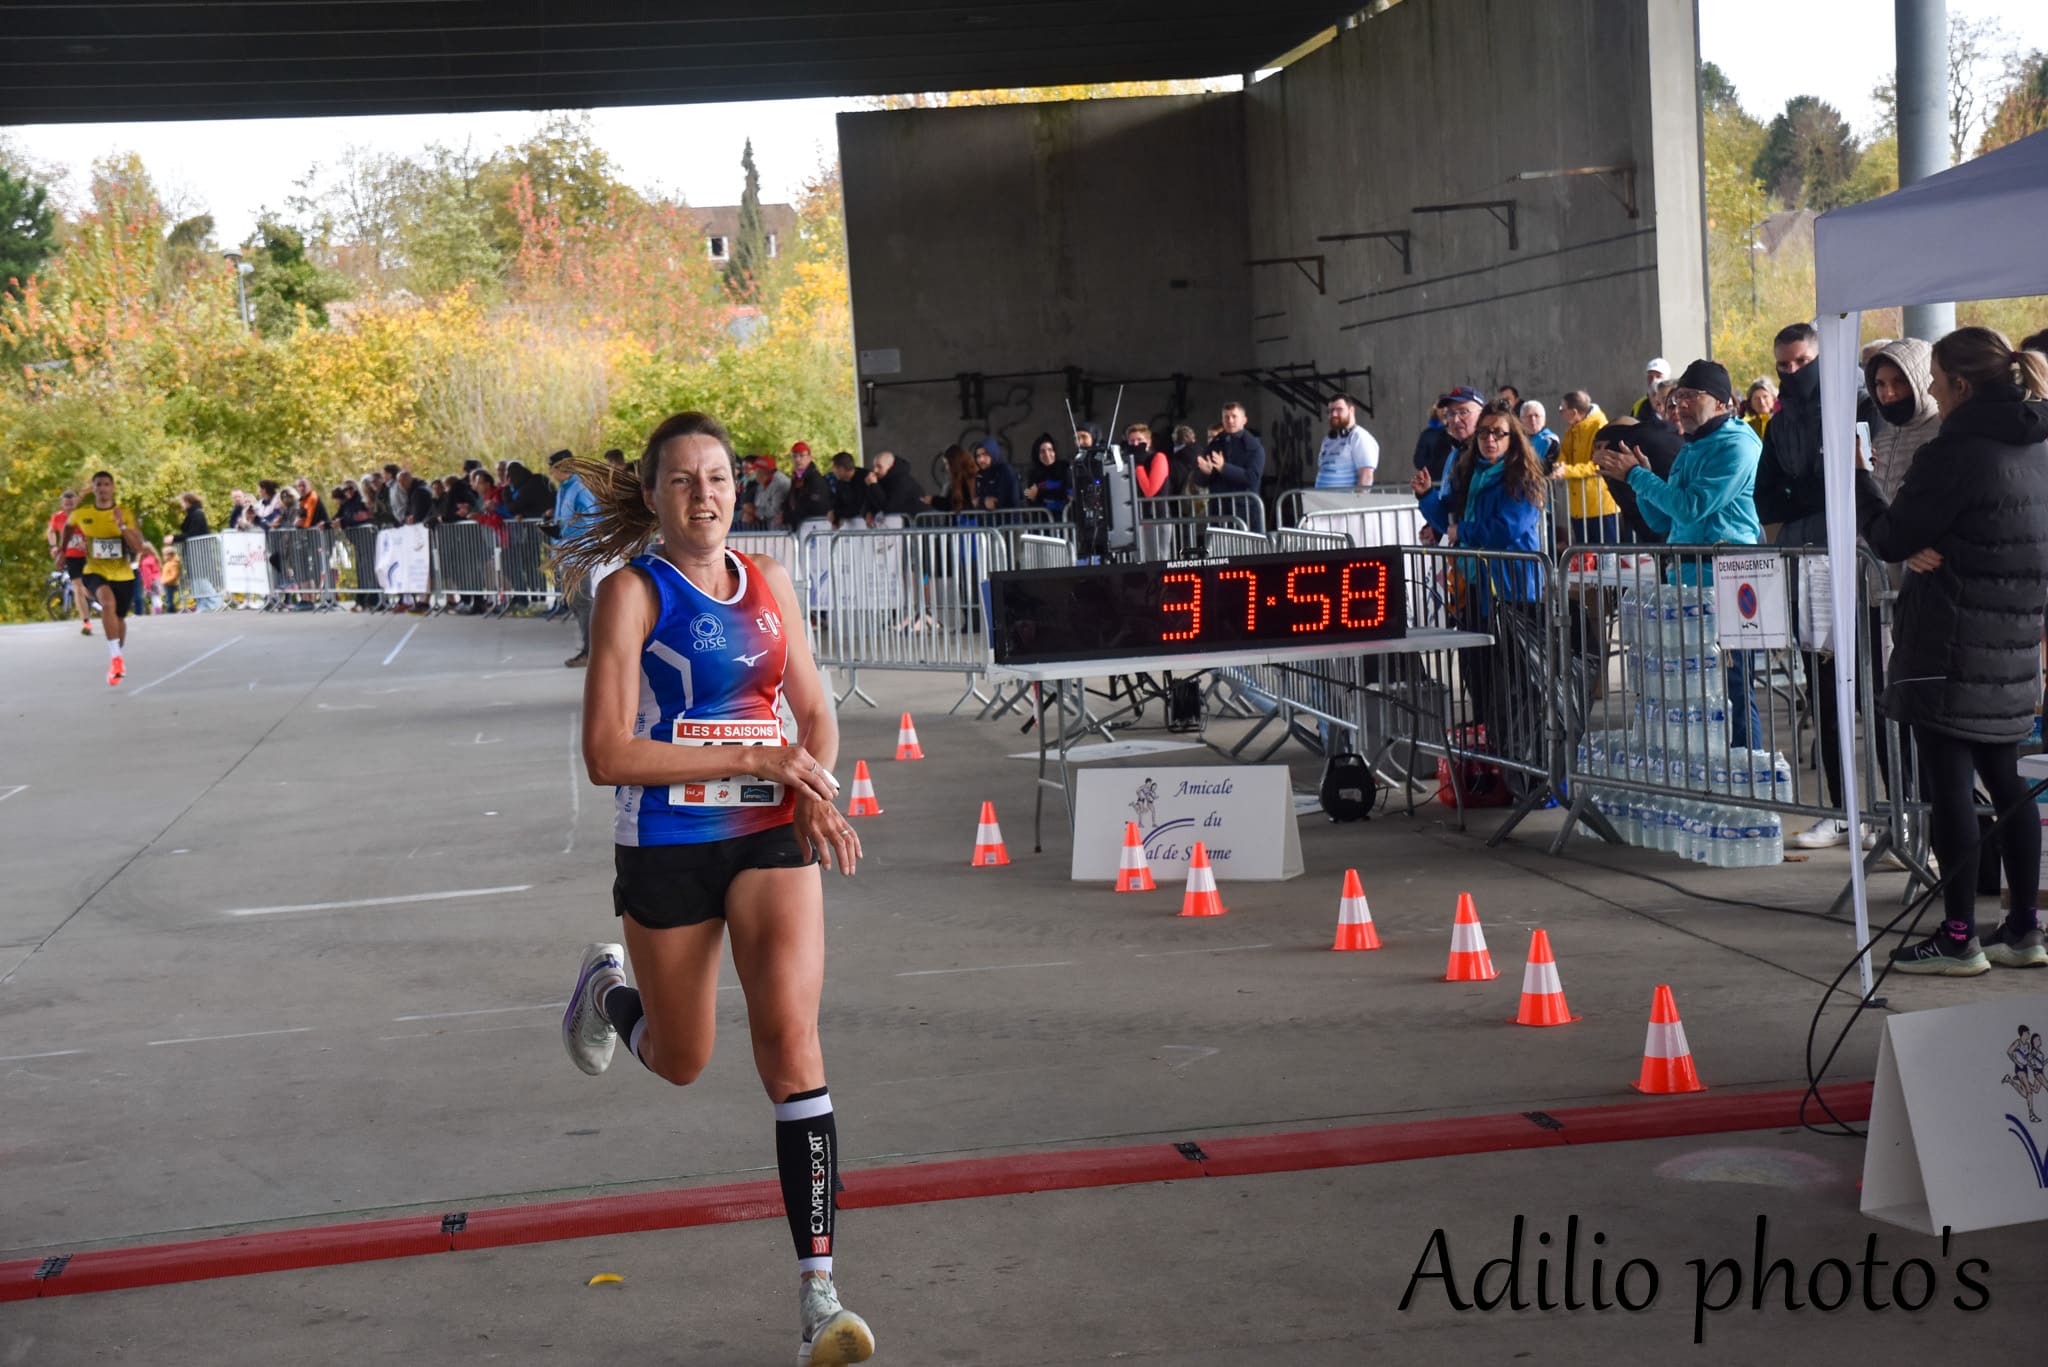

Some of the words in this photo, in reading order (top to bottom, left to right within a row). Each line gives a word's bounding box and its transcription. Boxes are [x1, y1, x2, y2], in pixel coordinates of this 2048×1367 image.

[1167, 559, 1202, 569] MATSPORT
[1203, 558, 1230, 567] TIMING
[683, 726, 710, 737] LES
[713, 726, 721, 737] 4
[724, 726, 774, 737] SAISONS
[1173, 778, 1233, 798] Amicale
[1203, 811, 1222, 827] du
[1162, 844, 1179, 860] de
